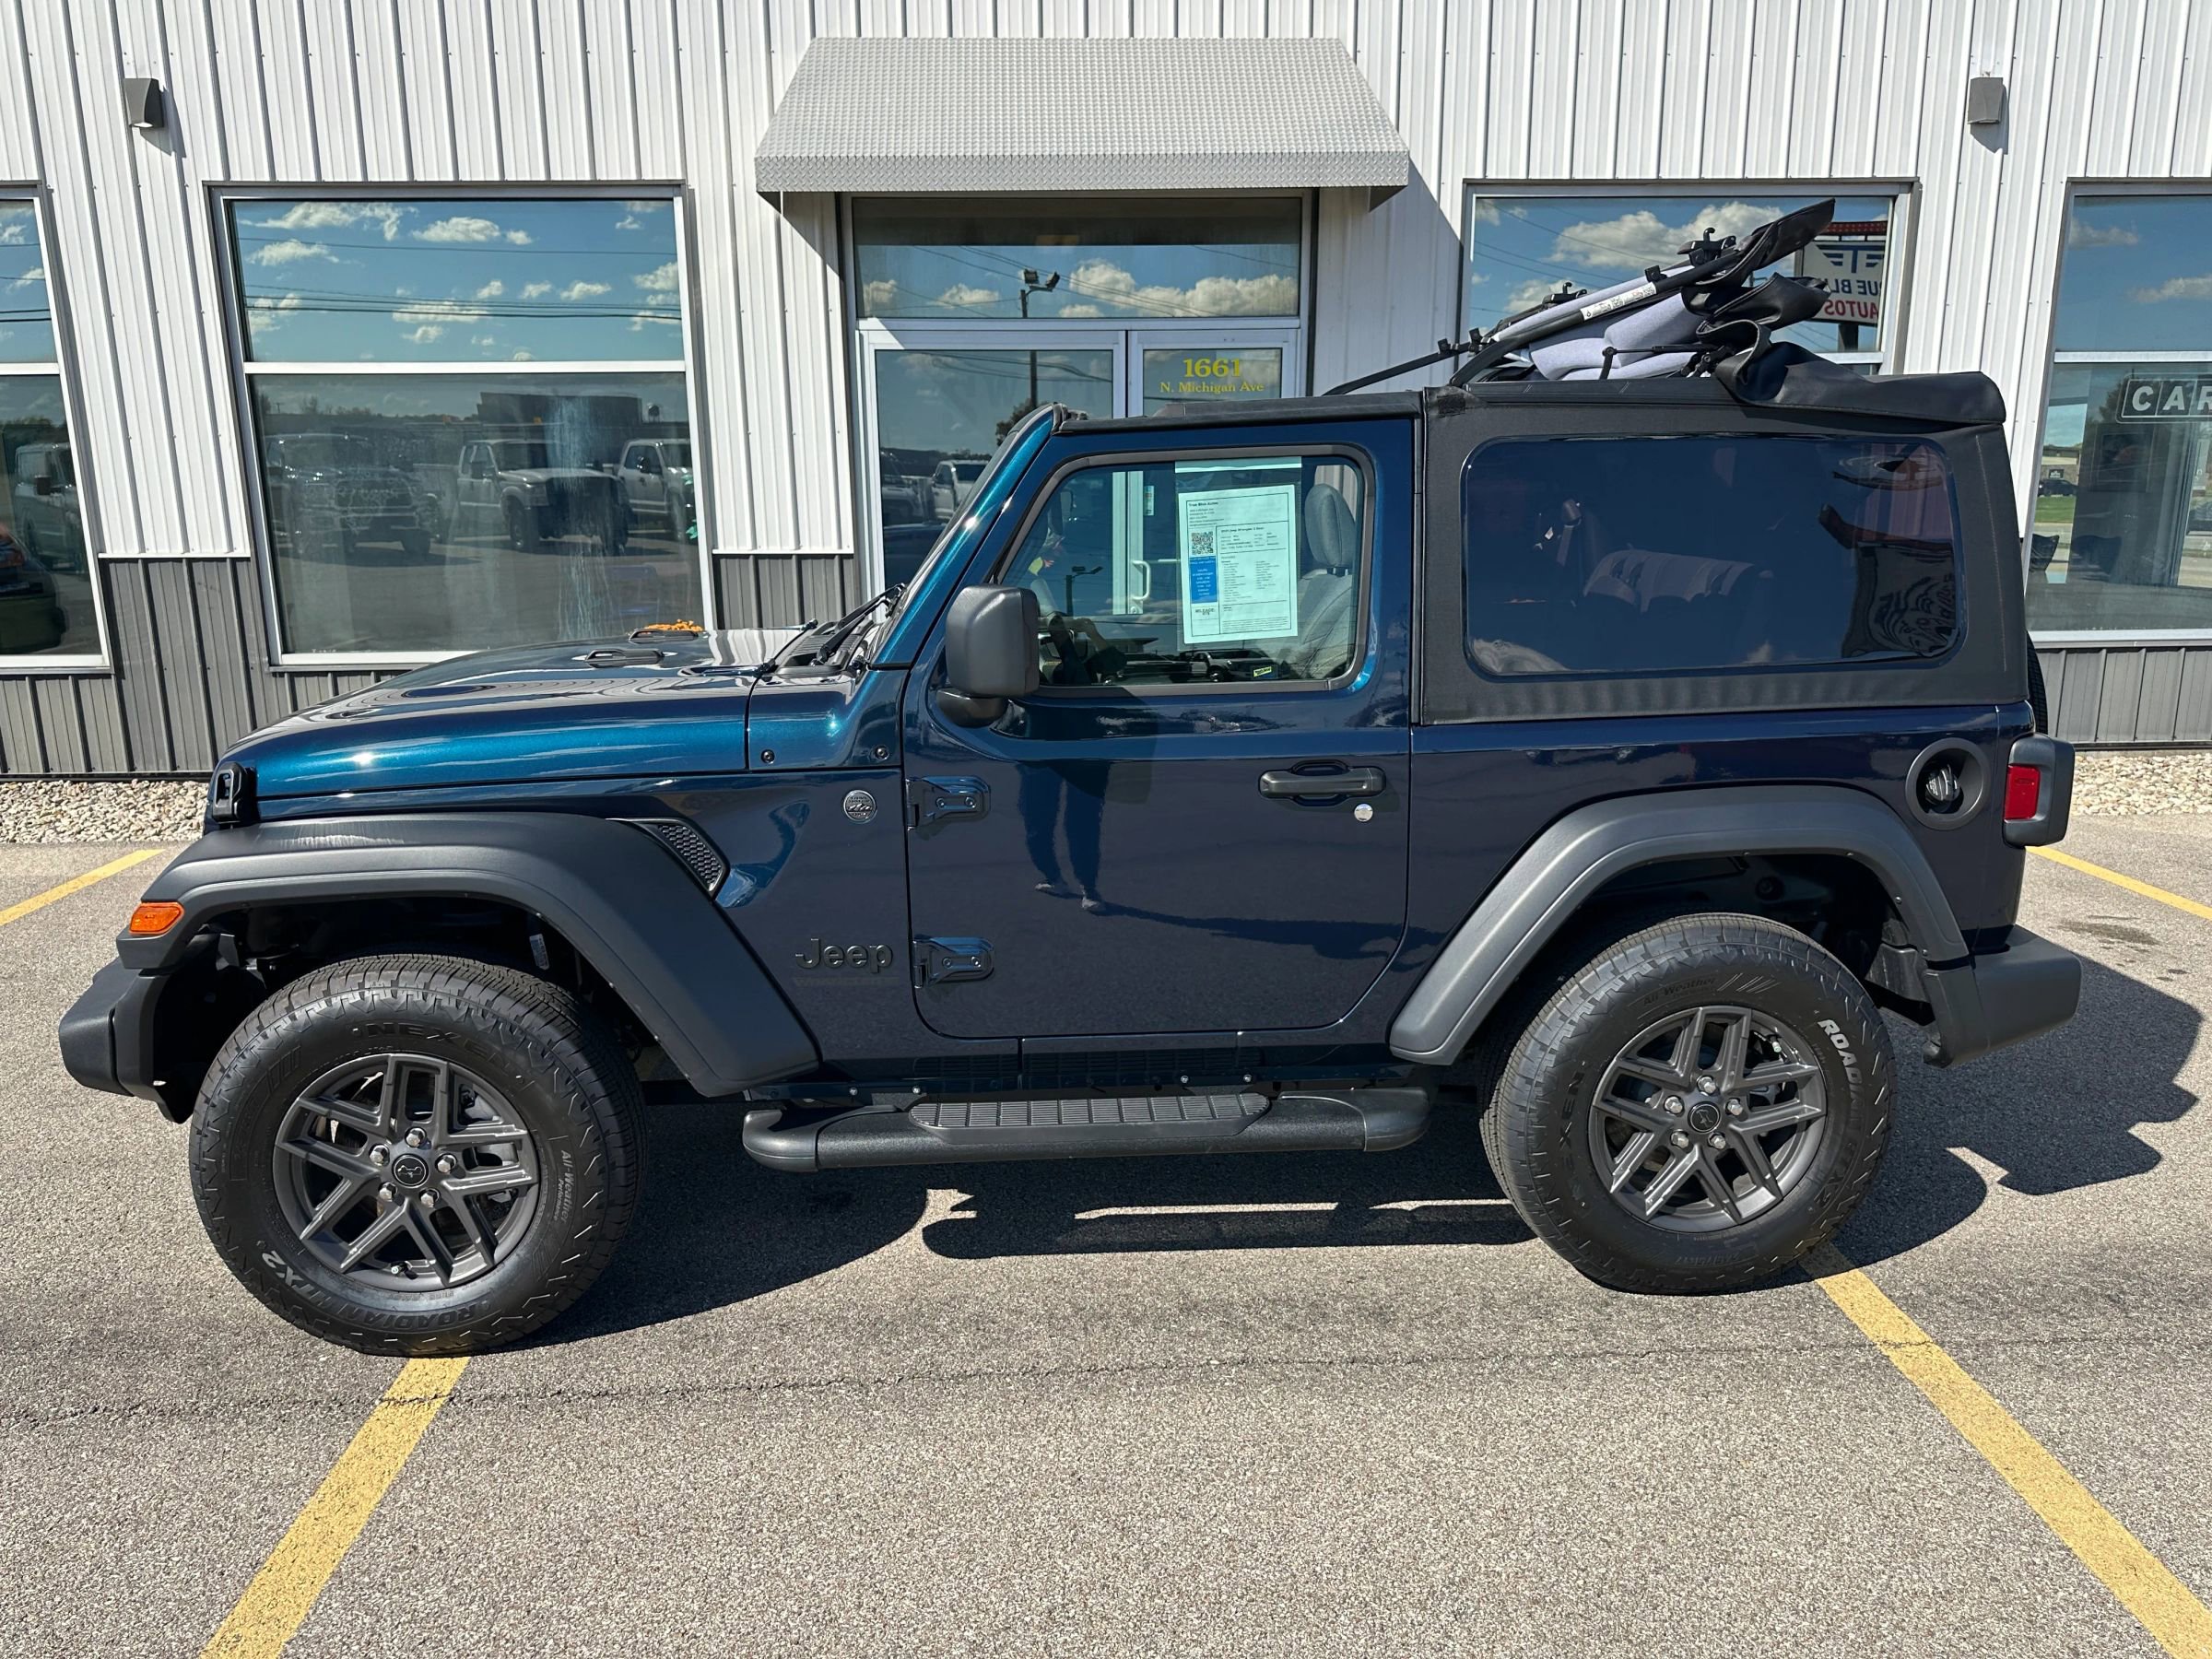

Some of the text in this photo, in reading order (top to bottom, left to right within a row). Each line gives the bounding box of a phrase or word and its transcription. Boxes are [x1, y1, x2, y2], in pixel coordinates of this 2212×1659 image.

[1182, 358, 1241, 378] 1661
[1159, 381, 1265, 394] N. Michigan Ave
[795, 938, 893, 973] Jeep
[365, 1022, 511, 1077] NEXEN
[560, 1150, 575, 1223] All-Weather
[338, 1303, 476, 1330] ROADIAN
